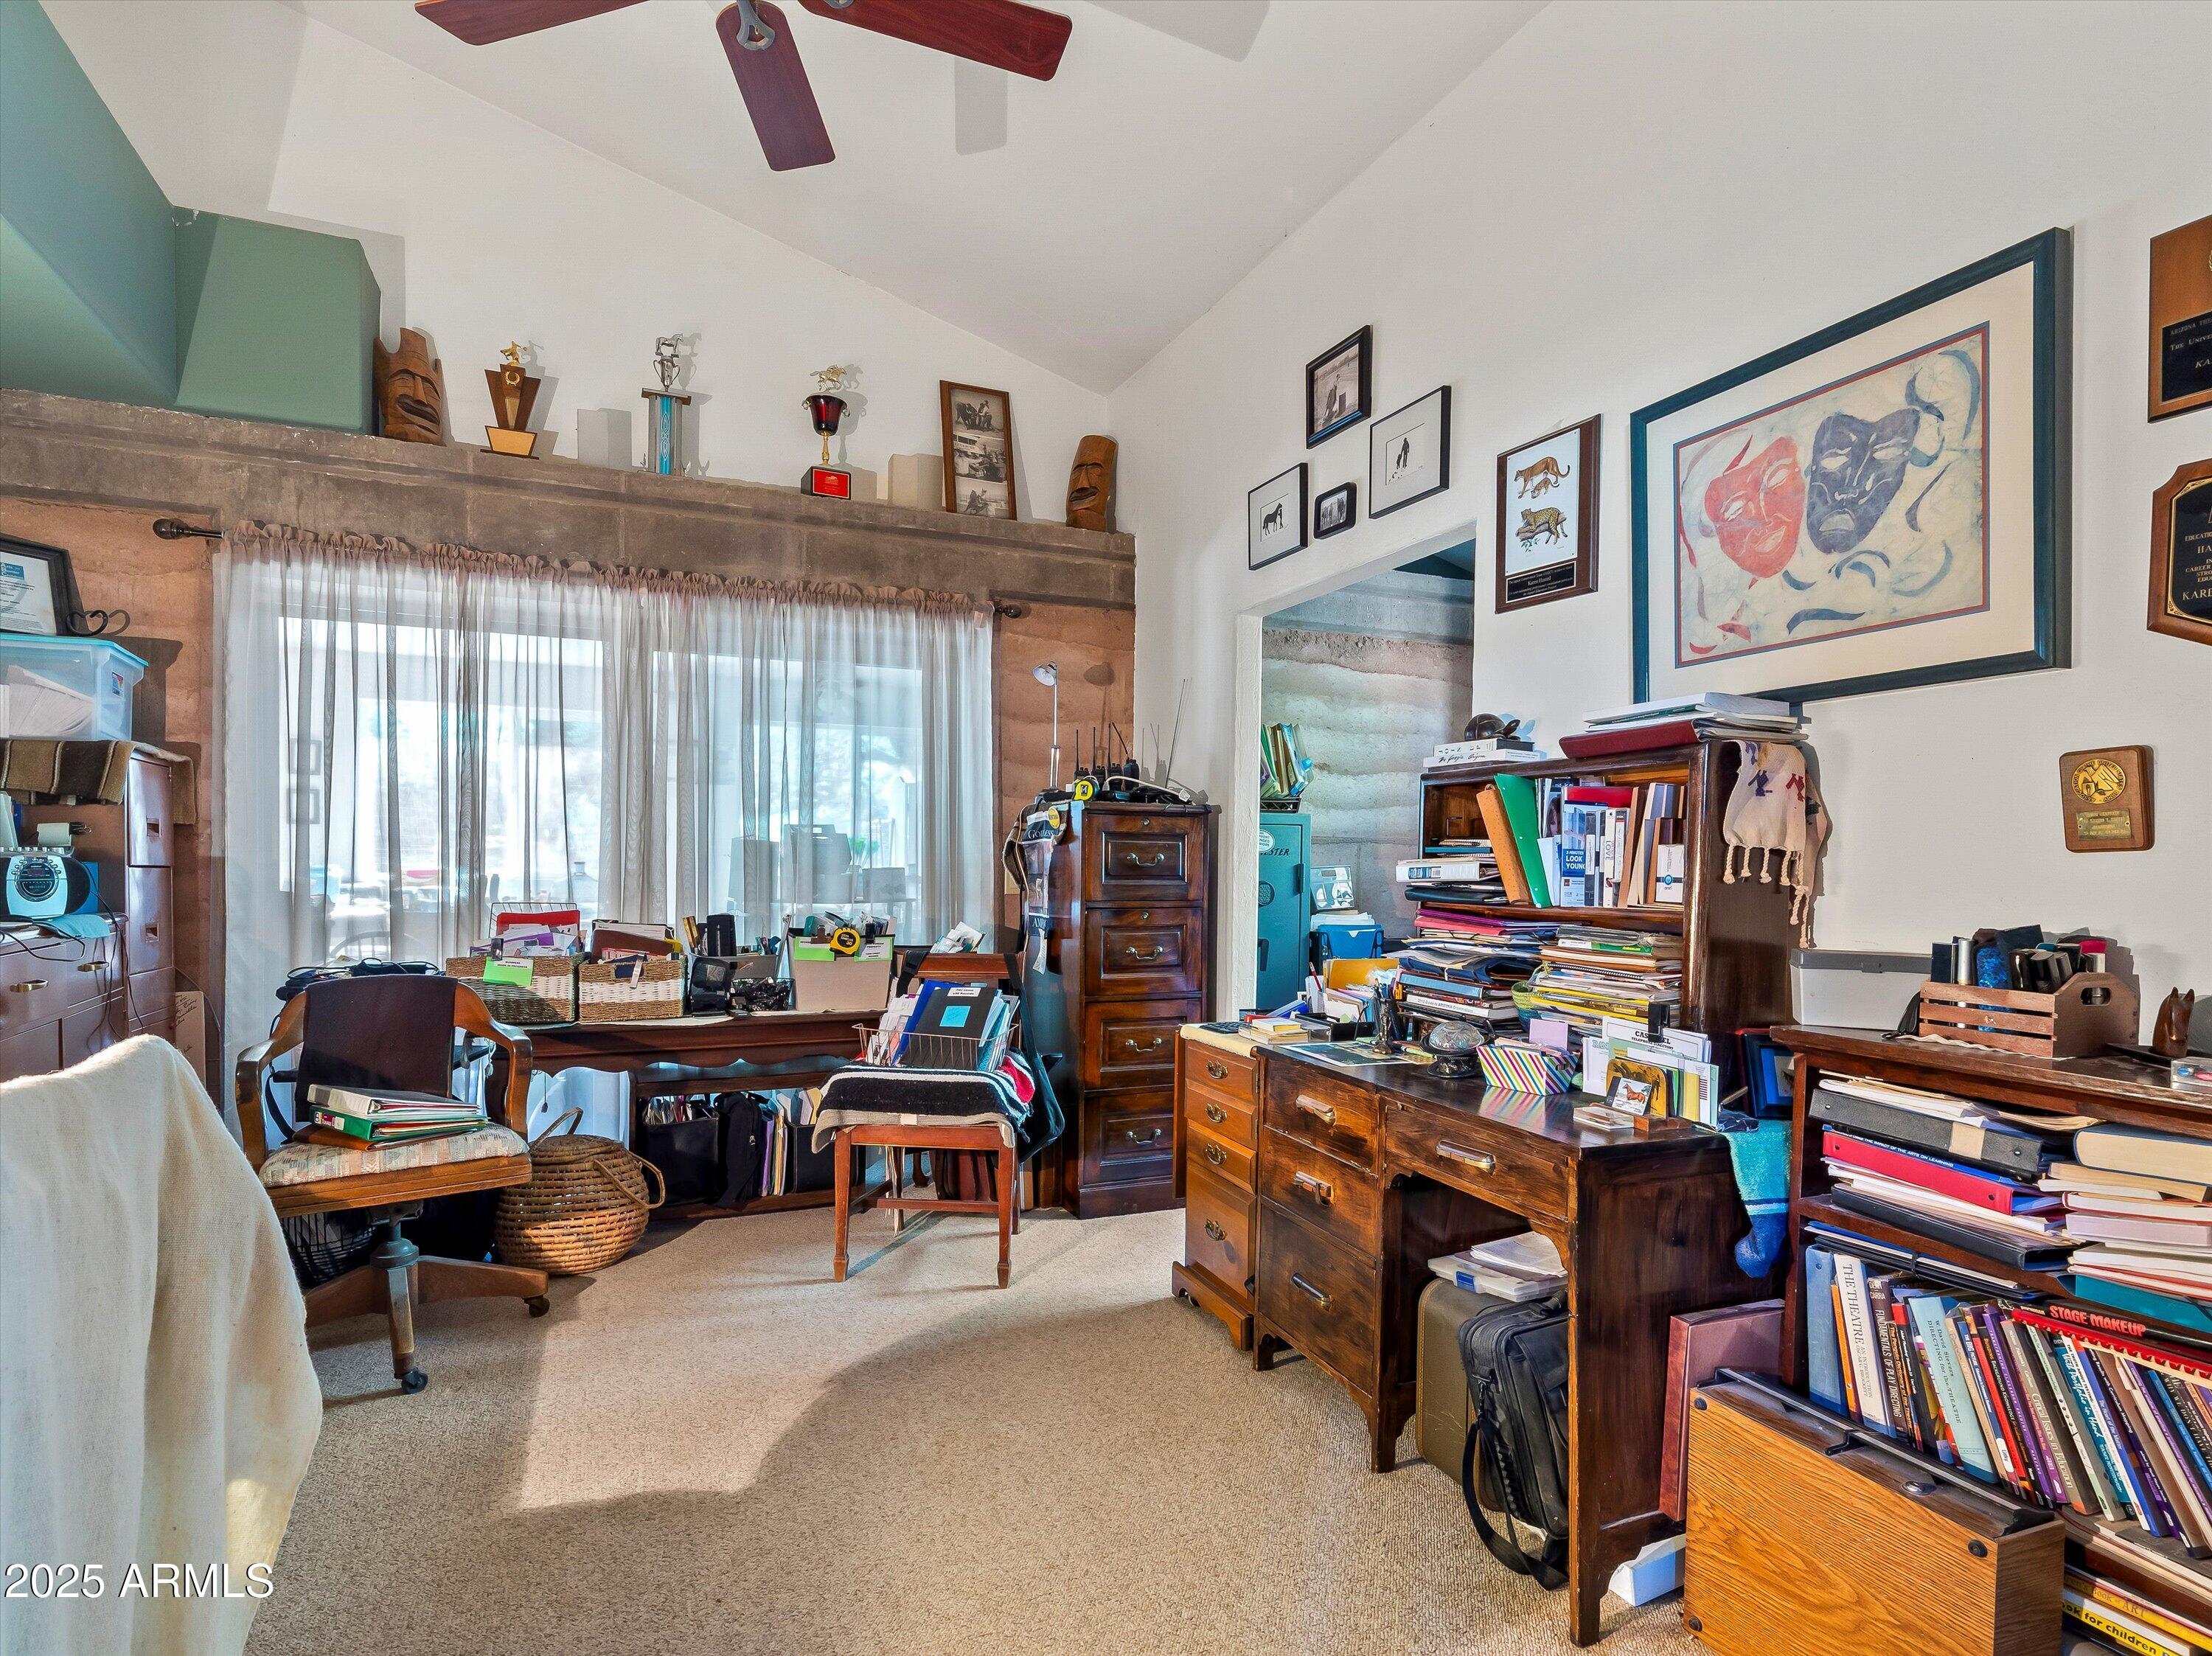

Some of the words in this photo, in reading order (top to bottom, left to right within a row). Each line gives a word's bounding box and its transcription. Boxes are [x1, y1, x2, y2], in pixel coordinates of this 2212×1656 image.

[2188, 335, 2212, 345] UNIVE
[2195, 358, 2212, 369] KA
[2185, 565, 2211, 573] CAREER
[1635, 1031, 1672, 1045] CASEL
[1873, 1140, 1890, 1148] IMPACT
[1927, 1156, 1954, 1167] LEARNING
[1842, 1265, 1855, 1287] THE
[1869, 1292, 1886, 1300] CARRA
[1846, 1290, 1865, 1344] THEATRE
[2049, 1305, 2088, 1325] STAGE
[2090, 1315, 2147, 1337] MAKEUP
[1874, 1309, 1892, 1356] FUNDAMENTALS
[1888, 1326, 1896, 1337] The
[1926, 1321, 1944, 1360] DIRECTING
[1890, 1338, 1900, 1360] Penguin
[1936, 1329, 1947, 1348] David
[1943, 1351, 1955, 1376] Sievers
[1965, 1341, 1975, 1351] BIG
[1969, 1351, 1978, 1365] PICTURE
[1883, 1358, 1893, 1366] OF
[1938, 1363, 1947, 1373] for
[2061, 1354, 2074, 1368] With
[2070, 1353, 2079, 1366] TRUTH
[2076, 1368, 2085, 1382] ABOUT
[1862, 1356, 1873, 1398] INTRODUCTION
[1885, 1368, 1896, 1383] PLAY
[1893, 1360, 1905, 1388] Dictionary
[1942, 1375, 1951, 1385] the
[1983, 1338, 1995, 1360] BUILDING
[1990, 1360, 2006, 1391] BACKGROUND
[2000, 1391, 2015, 1419] KNOWLEDGE
[1988, 1330, 2006, 1369] TRANSFORMING
[2003, 1373, 2017, 1404] CLASSROOM
[2014, 1408, 2027, 1431] GRADING
[2067, 1371, 2089, 1404] Portfolio
[2094, 1361, 2106, 1376] Results
[2102, 1377, 2111, 1386] with
[2107, 1387, 2124, 1411] Curriculum
[2118, 1412, 2135, 1433] Mapping
[1888, 1385, 1902, 1417] DIRECTING
[1945, 1386, 1962, 1423] THEATRE
[2083, 1406, 2092, 1415] in
[1904, 1407, 1913, 1428] Theatre
[2163, 1377, 2176, 1392] WHY
[2173, 1396, 2183, 1406] WE
[2192, 1433, 2206, 1451] HAVE
[2087, 1416, 2104, 1437] Hand
[2101, 1408, 2111, 1419] Heart
[2112, 1434, 2124, 1450] Matter
[2031, 1393, 2049, 1417] Critical
[2041, 1419, 2057, 1440] Issues
[2053, 1452, 2074, 1487] Education
[2029, 1450, 2042, 1474] MARZANO
[2124, 1599, 2146, 1618] ART
[2084, 1612, 2103, 1627] for
[2106, 1624, 2157, 1655] children
